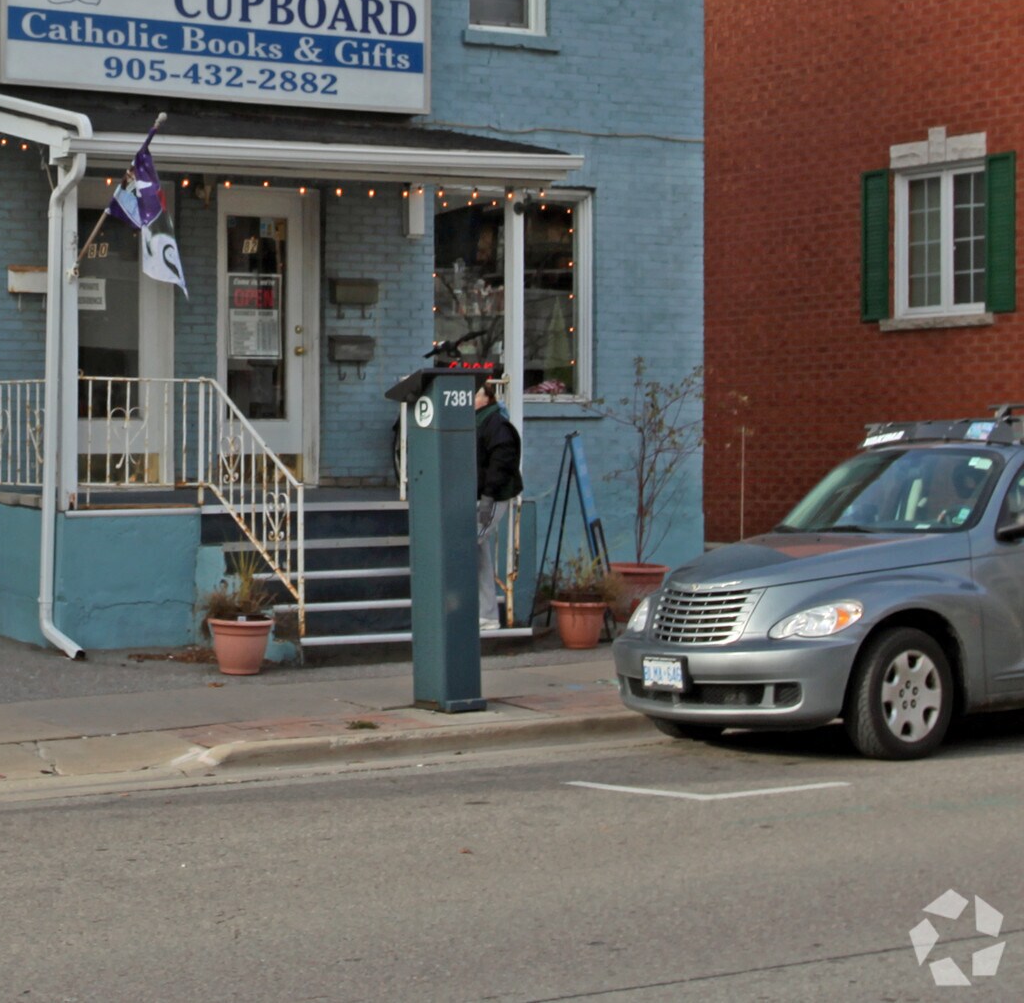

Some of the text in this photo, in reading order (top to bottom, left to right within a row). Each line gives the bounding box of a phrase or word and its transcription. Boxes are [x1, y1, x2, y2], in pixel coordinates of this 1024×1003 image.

[21, 12, 411, 70] Catholic Books & Gifts
[103, 55, 339, 96] 905-432-2882
[233, 287, 274, 308] OPEN
[443, 390, 474, 408] 7381
